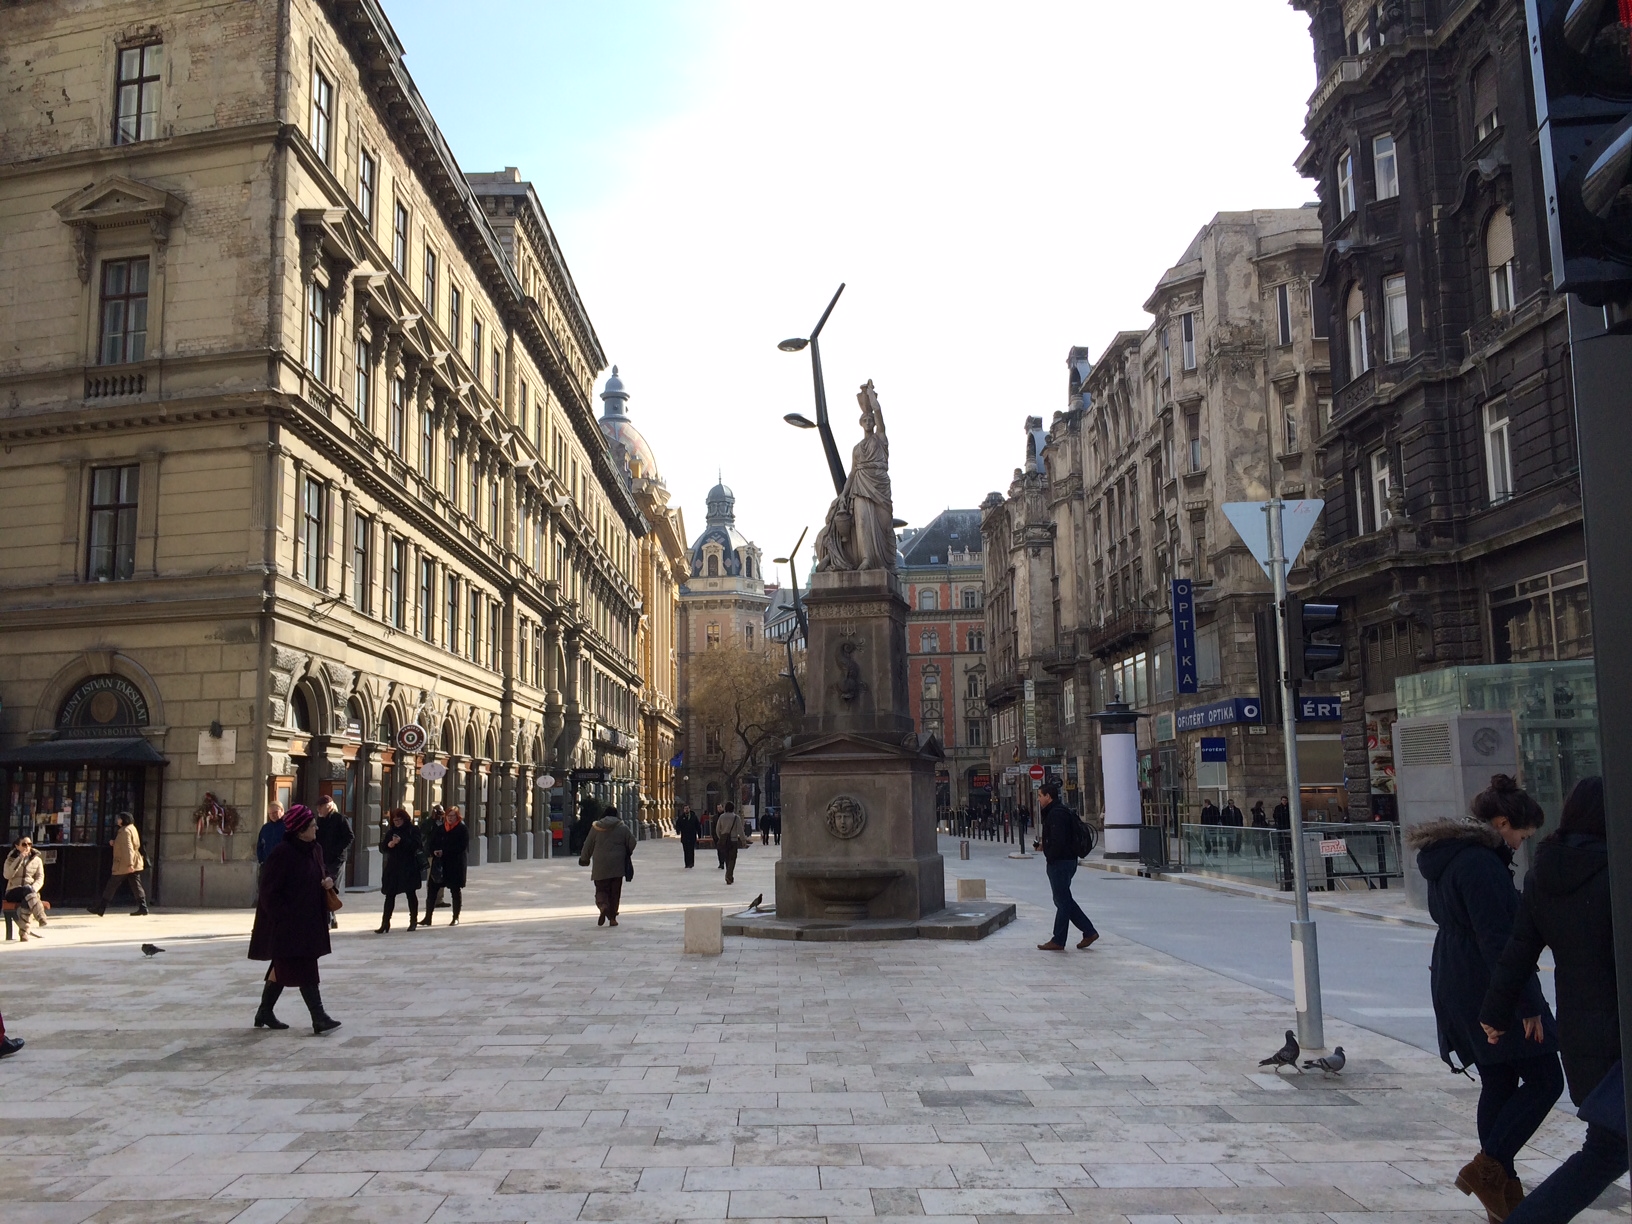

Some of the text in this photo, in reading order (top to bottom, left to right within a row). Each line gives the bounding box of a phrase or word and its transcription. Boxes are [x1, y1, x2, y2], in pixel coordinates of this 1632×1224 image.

[1177, 584, 1193, 684] OPTIKA
[62, 690, 82, 724] SZENT
[115, 679, 147, 721] TÁRSULAT
[1208, 706, 1234, 722] OPTIKA
